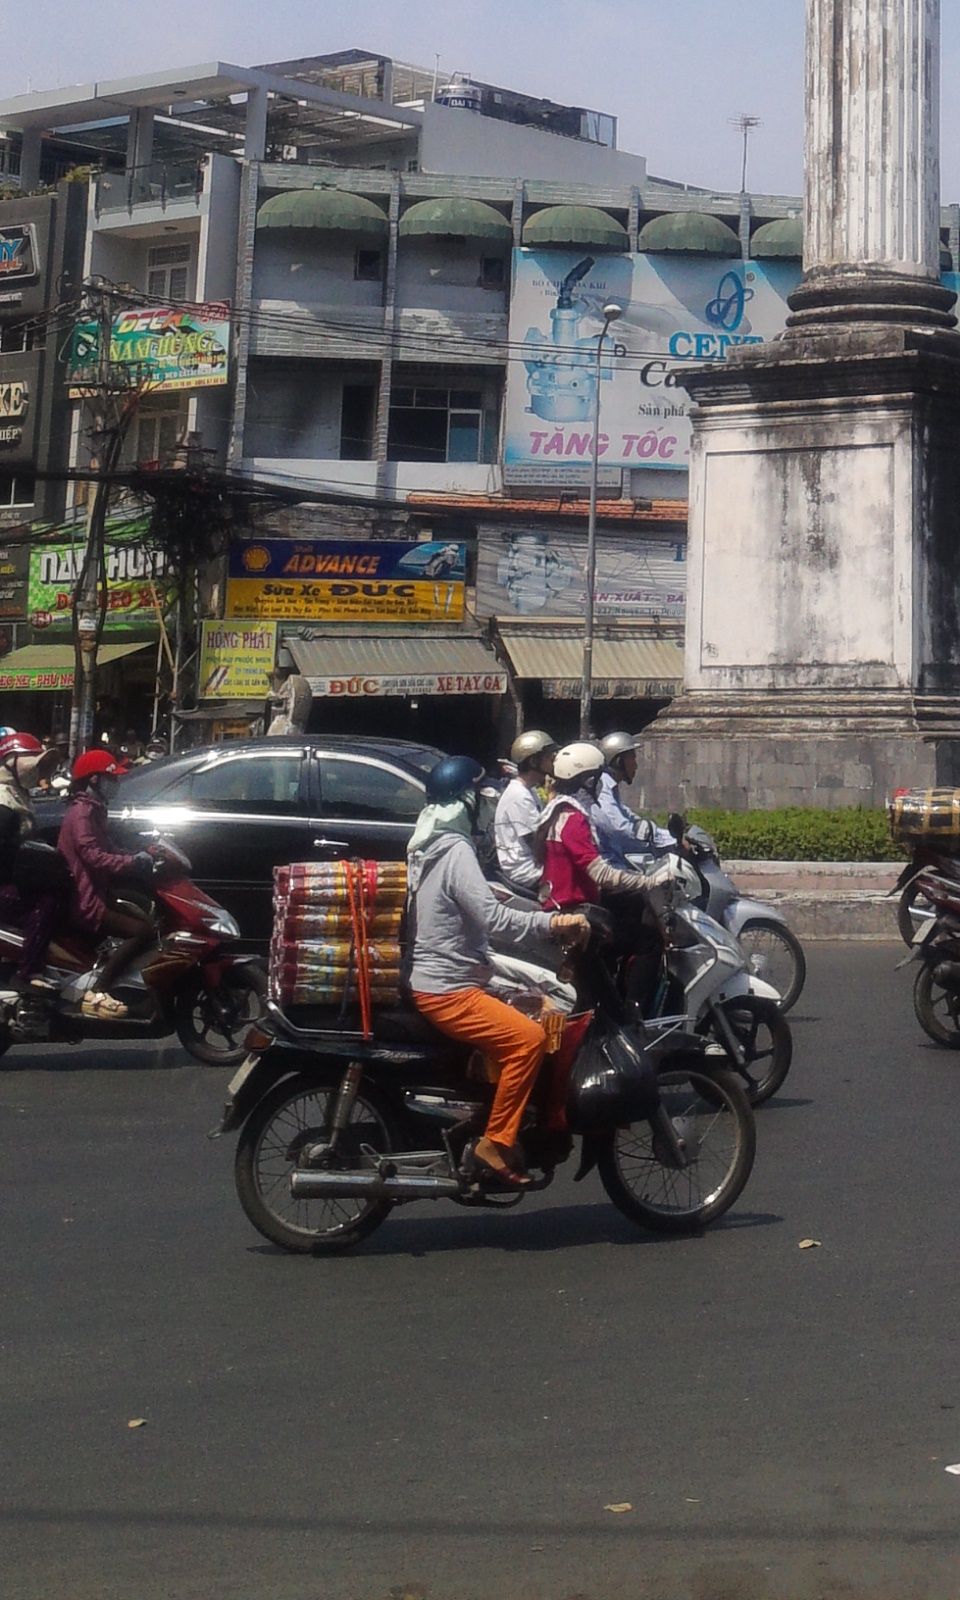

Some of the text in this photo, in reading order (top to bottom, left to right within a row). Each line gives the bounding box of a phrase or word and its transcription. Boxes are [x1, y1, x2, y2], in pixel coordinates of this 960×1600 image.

[622, 425, 678, 458] TỐC
[284, 554, 381, 574] ADVANCE
[329, 677, 380, 695] ĐỨC
[436, 677, 453, 692] XE
[456, 676, 481, 691] TAY
[484, 675, 501, 690] GA
